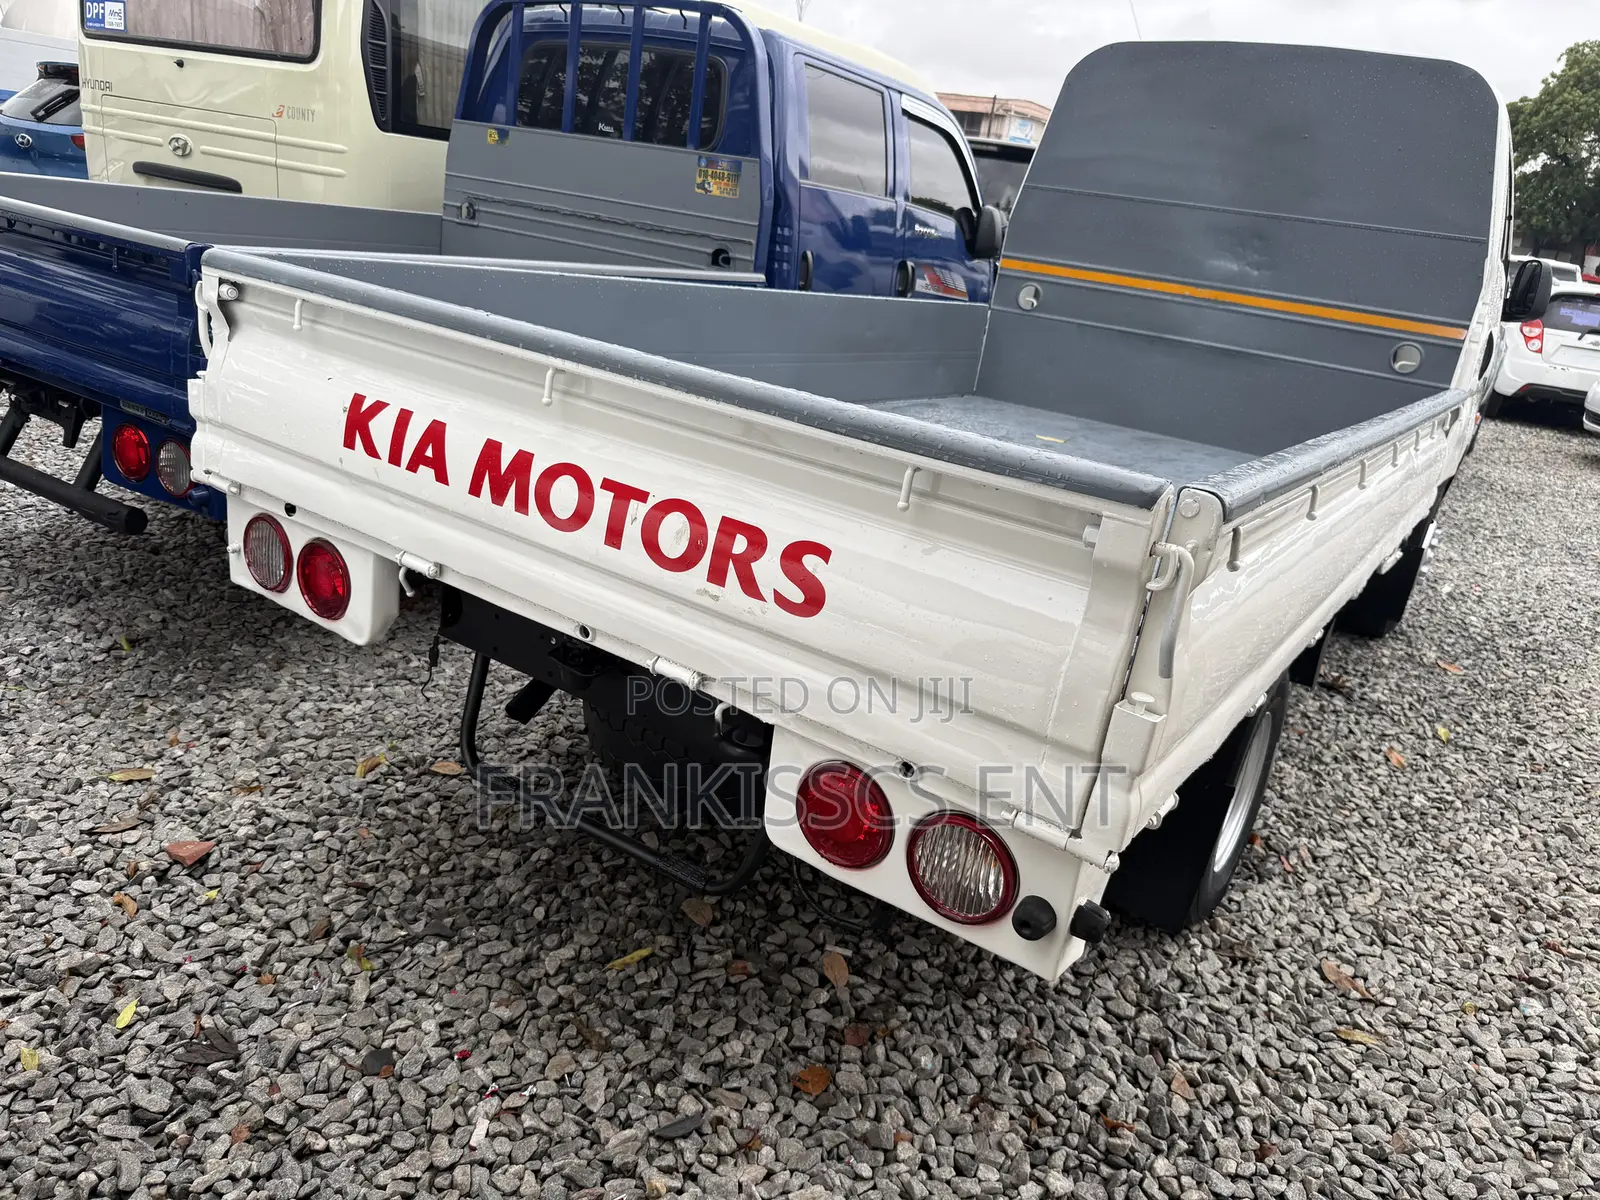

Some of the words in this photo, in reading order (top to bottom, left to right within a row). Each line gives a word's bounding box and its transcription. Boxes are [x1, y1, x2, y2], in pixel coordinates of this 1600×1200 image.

[86, 2, 104, 19] DPF
[82, 78, 113, 92] HYUNDAI
[287, 106, 316, 123] COUNTY
[342, 392, 450, 486] KIA
[467, 438, 833, 618] MOTORS
